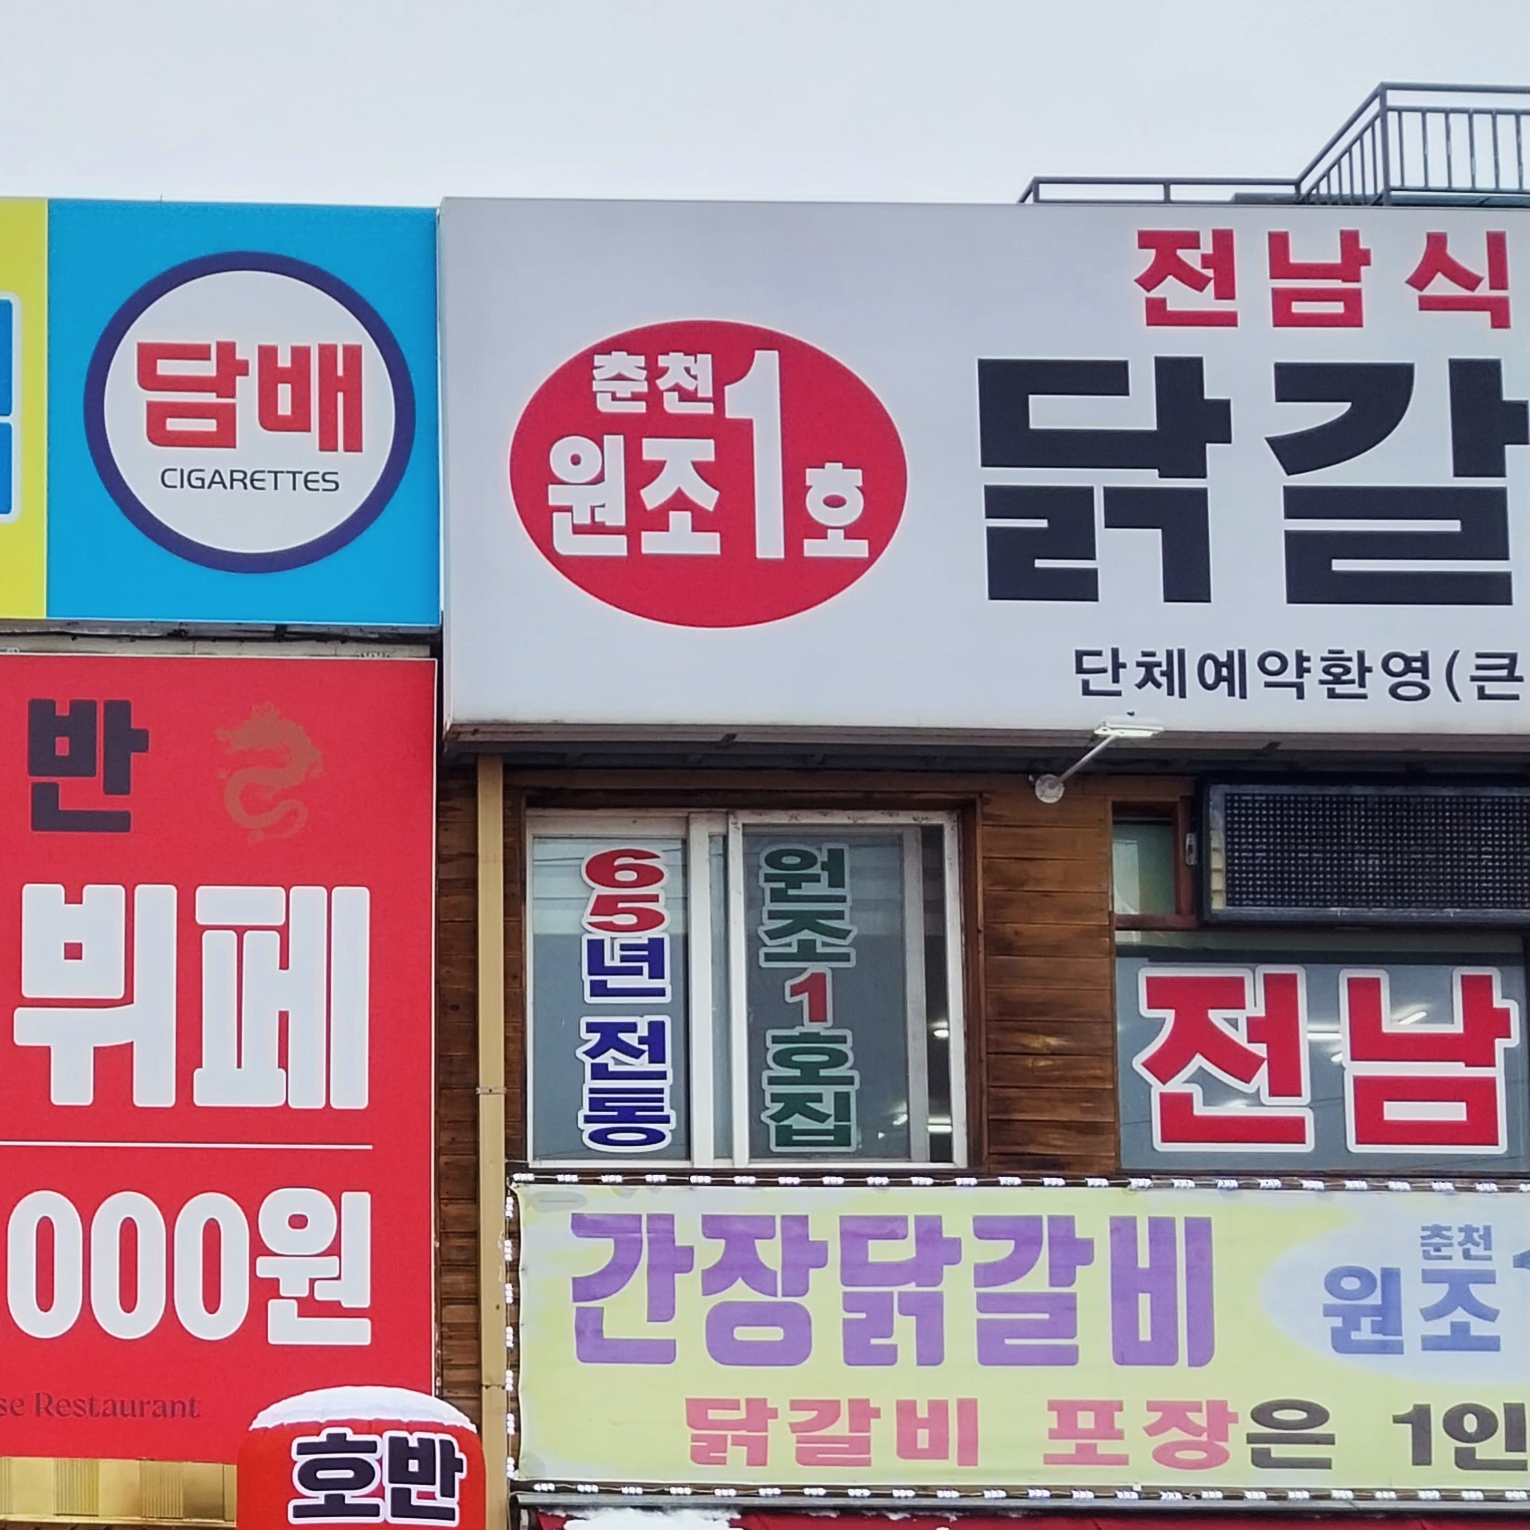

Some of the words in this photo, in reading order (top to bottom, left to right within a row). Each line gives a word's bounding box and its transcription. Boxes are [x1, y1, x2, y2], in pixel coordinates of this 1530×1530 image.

[1134, 228, 1512, 329] 전남식
[136, 339, 365, 453] 담배
[591, 350, 714, 415] 춘천
[160, 466, 341, 493] CIGARETTES
[547, 349, 870, 560] 원조1호
[977, 356, 1530, 605] 닭갈
[1074, 647, 1525, 703] 단체예약환영(큰
[582, 847, 671, 1003] 65년
[759, 842, 860, 1152] 원조1호집
[577, 1015, 675, 1153] 전통
[1133, 965, 1519, 1154] 전남
[569, 1212, 1215, 1368] 간장닭갈비
[1420, 1224, 1493, 1261] 춘천
[34, 1391, 201, 1419] Restaurant
[685, 1396, 979, 1469] 닭갈비
[1042, 1397, 1337, 1470] 포장은
[1392, 1402, 1529, 1471] 1인
[288, 1427, 467, 1527] 호반
